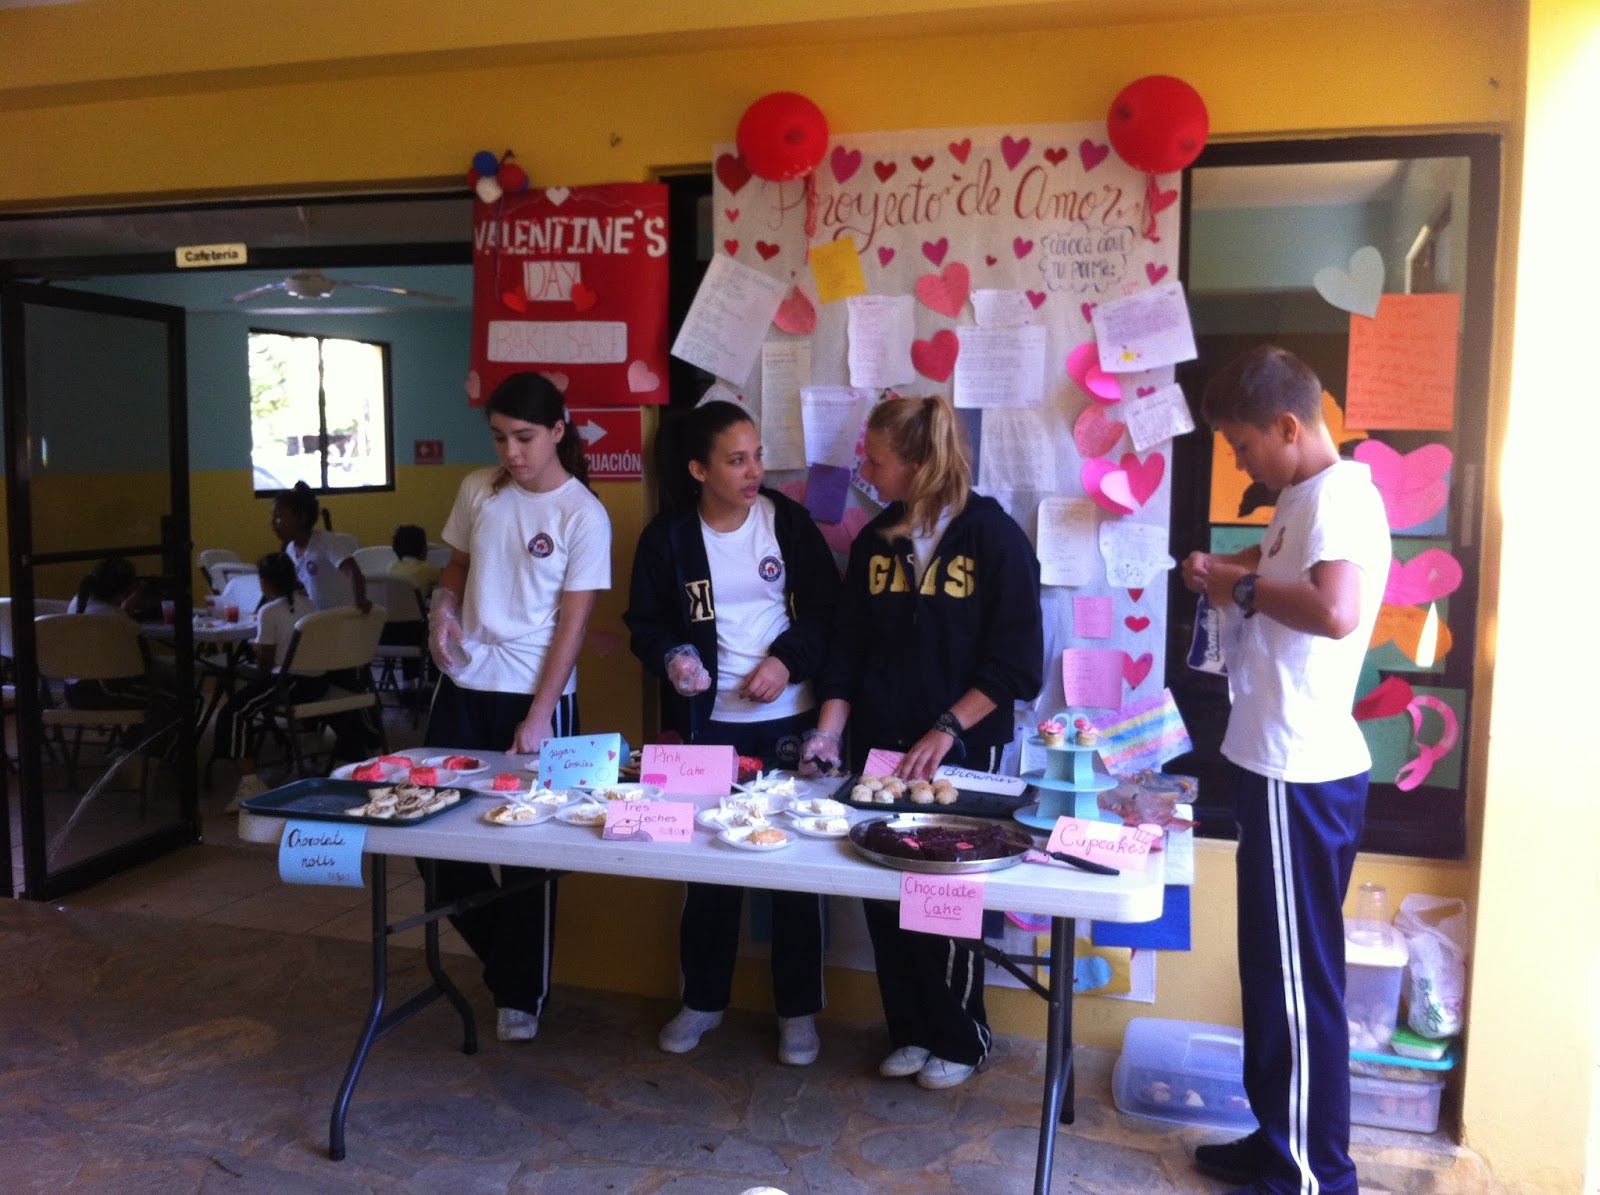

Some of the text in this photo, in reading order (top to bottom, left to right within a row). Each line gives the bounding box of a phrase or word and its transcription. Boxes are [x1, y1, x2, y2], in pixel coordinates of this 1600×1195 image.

[955, 158, 1000, 216] de
[474, 210, 668, 258] VALENTINE'S
[526, 261, 579, 300] DAY
[583, 449, 641, 472] CUACIÓN
[653, 746, 681, 762] Pink
[680, 761, 706, 776] Cake
[623, 800, 650, 812] Tres
[285, 828, 346, 848] Chocolate
[1060, 824, 1146, 856] Cupcakes
[905, 876, 977, 898] Chocolate
[924, 896, 962, 916] Cake
